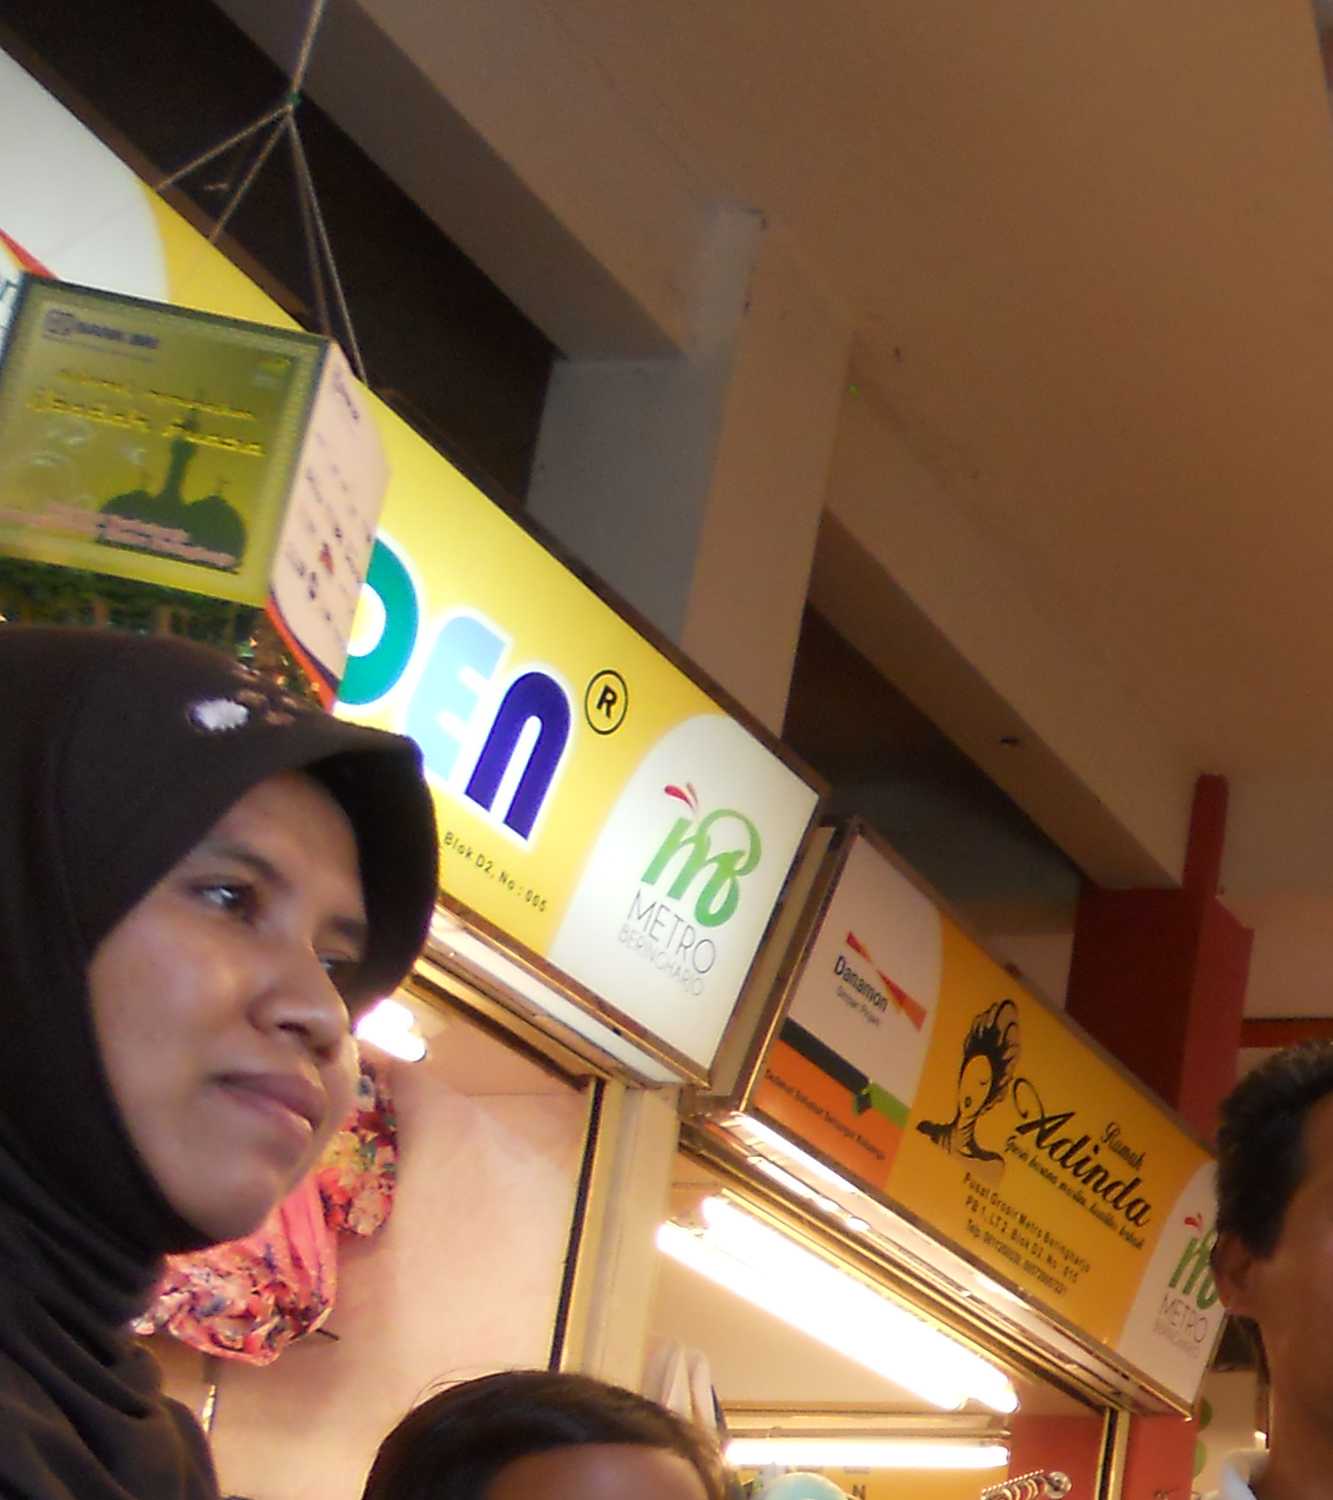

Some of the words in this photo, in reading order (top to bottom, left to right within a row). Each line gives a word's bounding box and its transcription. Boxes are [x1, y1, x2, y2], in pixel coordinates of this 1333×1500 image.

[444, 831, 472, 858] Blok
[627, 888, 716, 974] METRO
[834, 955, 888, 1012] Danamon
[1012, 1077, 1151, 1228] Adinda
